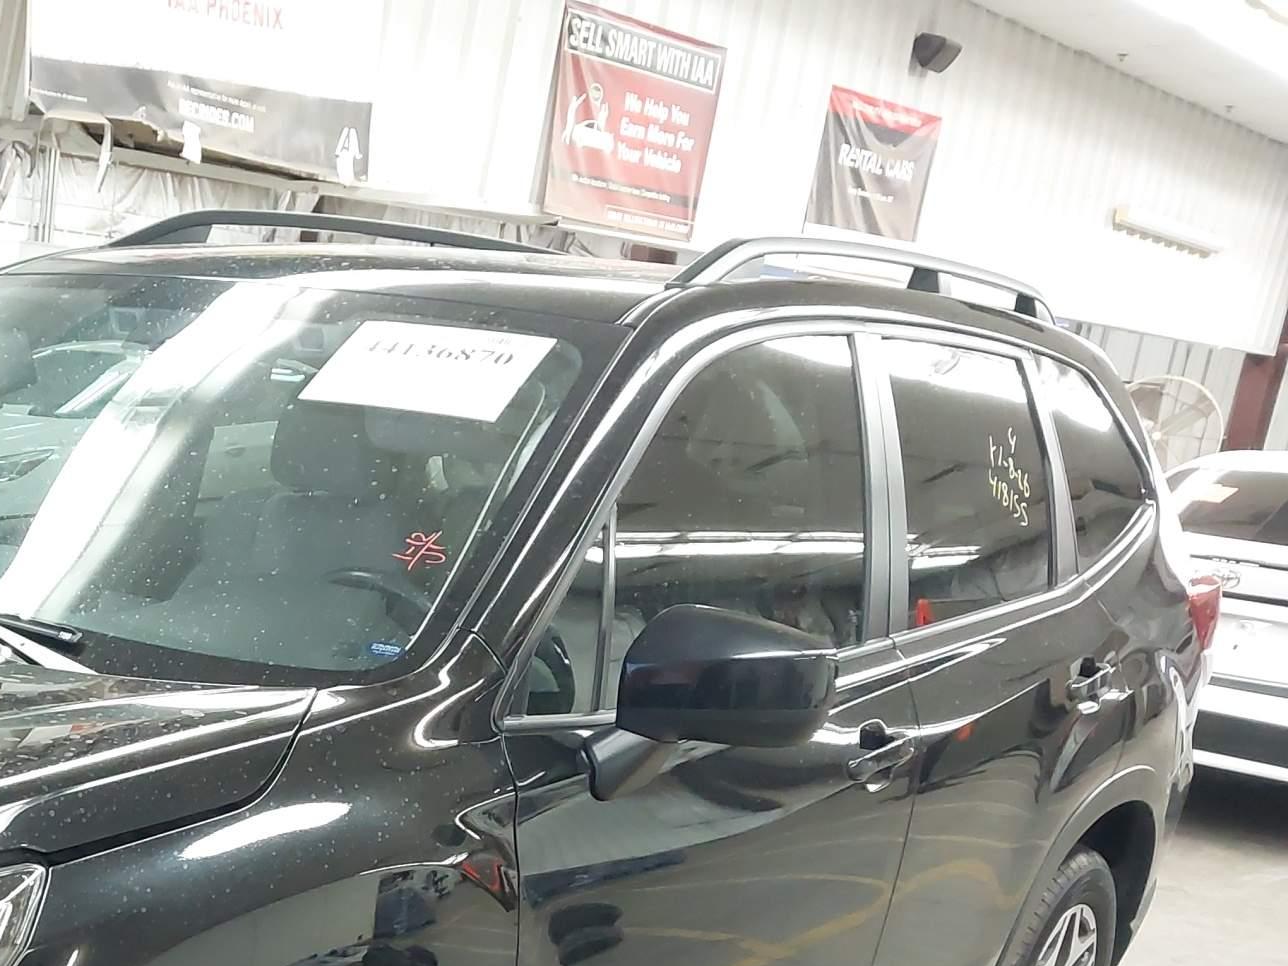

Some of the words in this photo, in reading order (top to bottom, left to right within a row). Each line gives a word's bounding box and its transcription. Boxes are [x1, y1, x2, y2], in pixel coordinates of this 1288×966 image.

[569, 17, 603, 52] SELL
[606, 29, 656, 67] SMART
[656, 45, 691, 79] WITH
[691, 54, 714, 86] IAA
[624, 91, 643, 113] We
[643, 97, 669, 123] Help
[670, 104, 690, 126] You
[619, 116, 646, 139] Earn
[647, 123, 676, 147] More
[676, 130, 695, 151] For
[617, 141, 642, 163] Your
[643, 147, 682, 173] Vehicle
[838, 143, 884, 175] RENTAL
